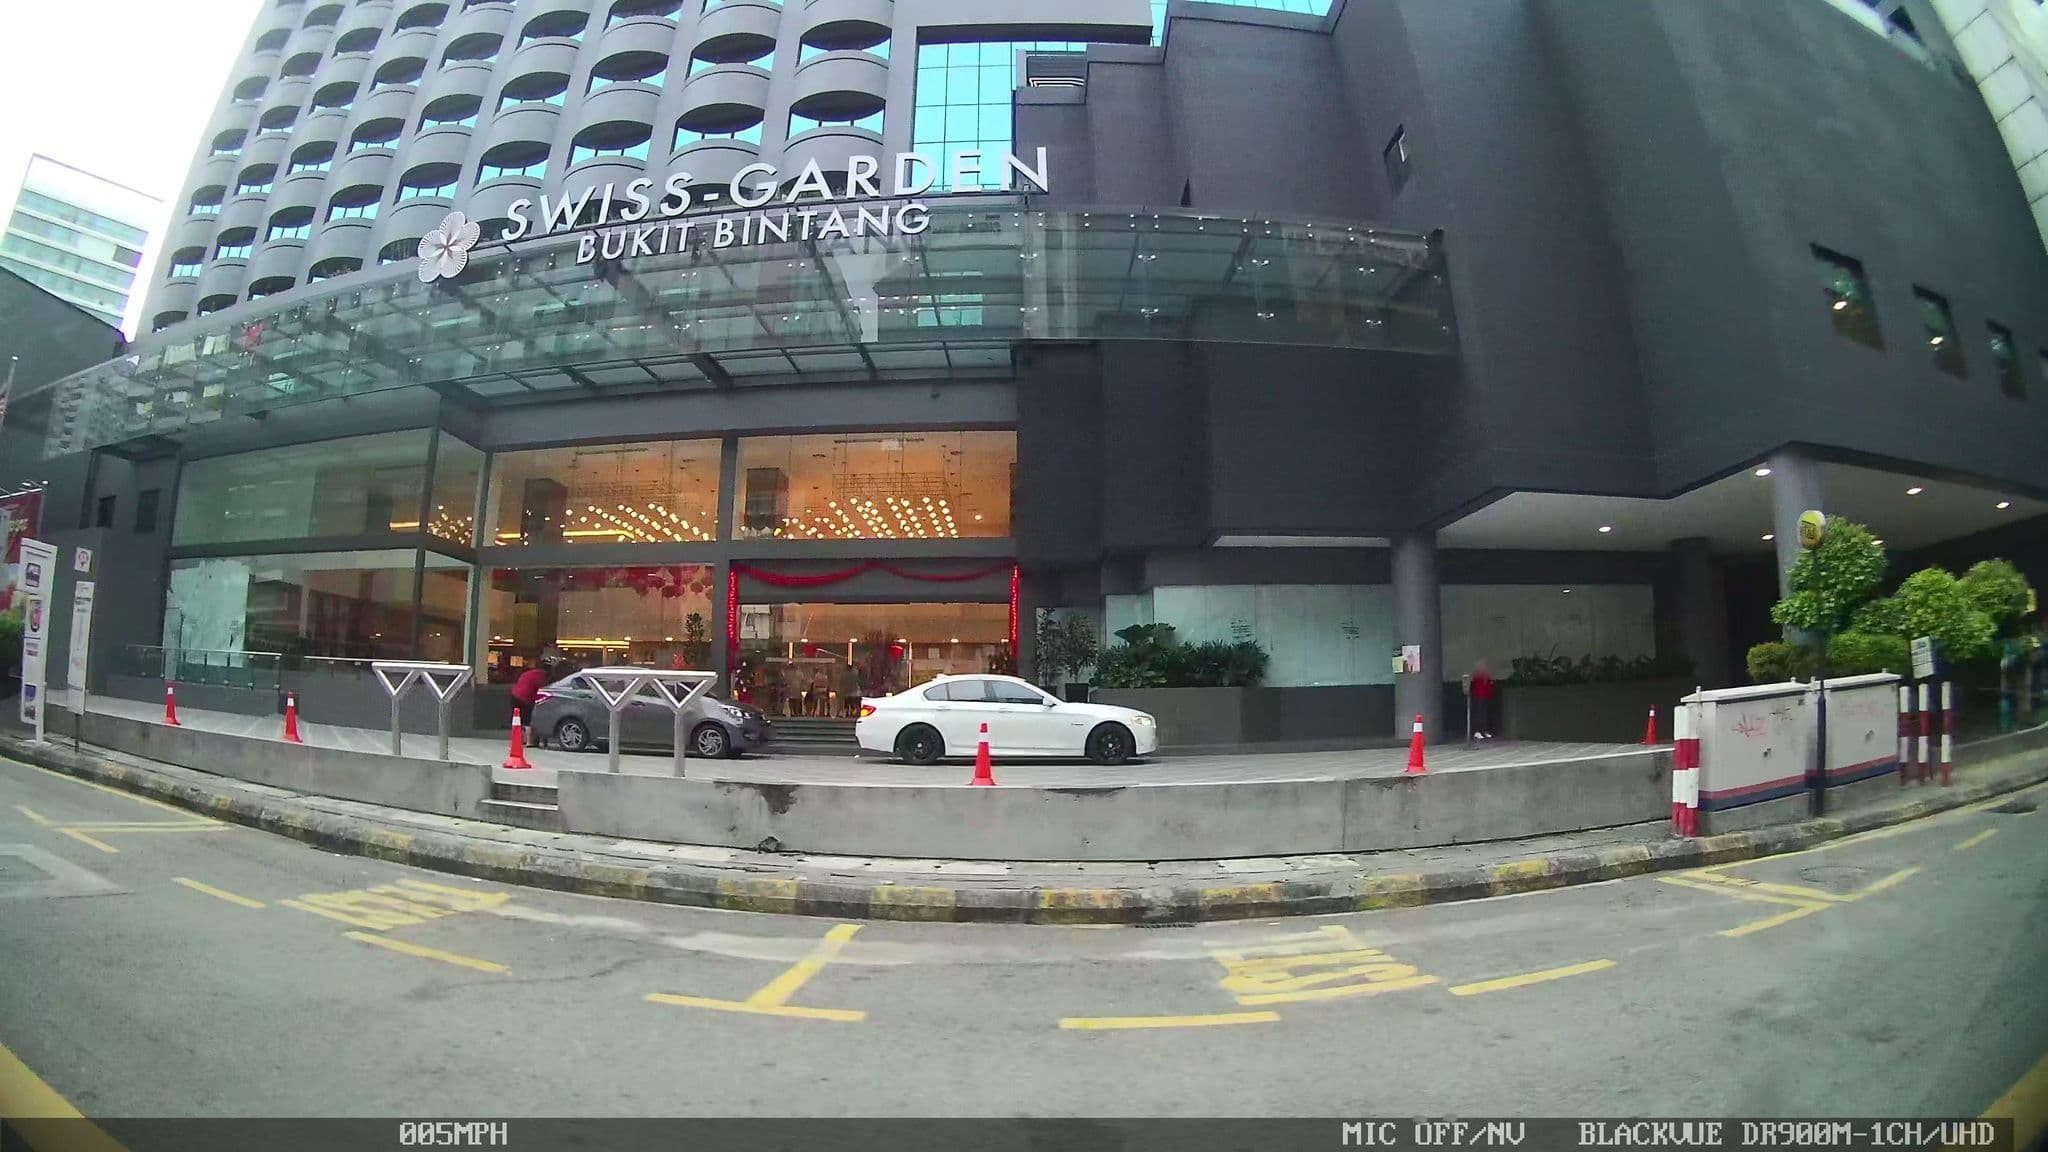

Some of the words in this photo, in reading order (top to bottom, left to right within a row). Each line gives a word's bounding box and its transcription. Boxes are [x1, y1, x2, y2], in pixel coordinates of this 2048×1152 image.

[501, 147, 1049, 241] SWISS-GARDEN
[576, 222, 695, 265] BUKIT
[713, 203, 931, 250] BINTANG
